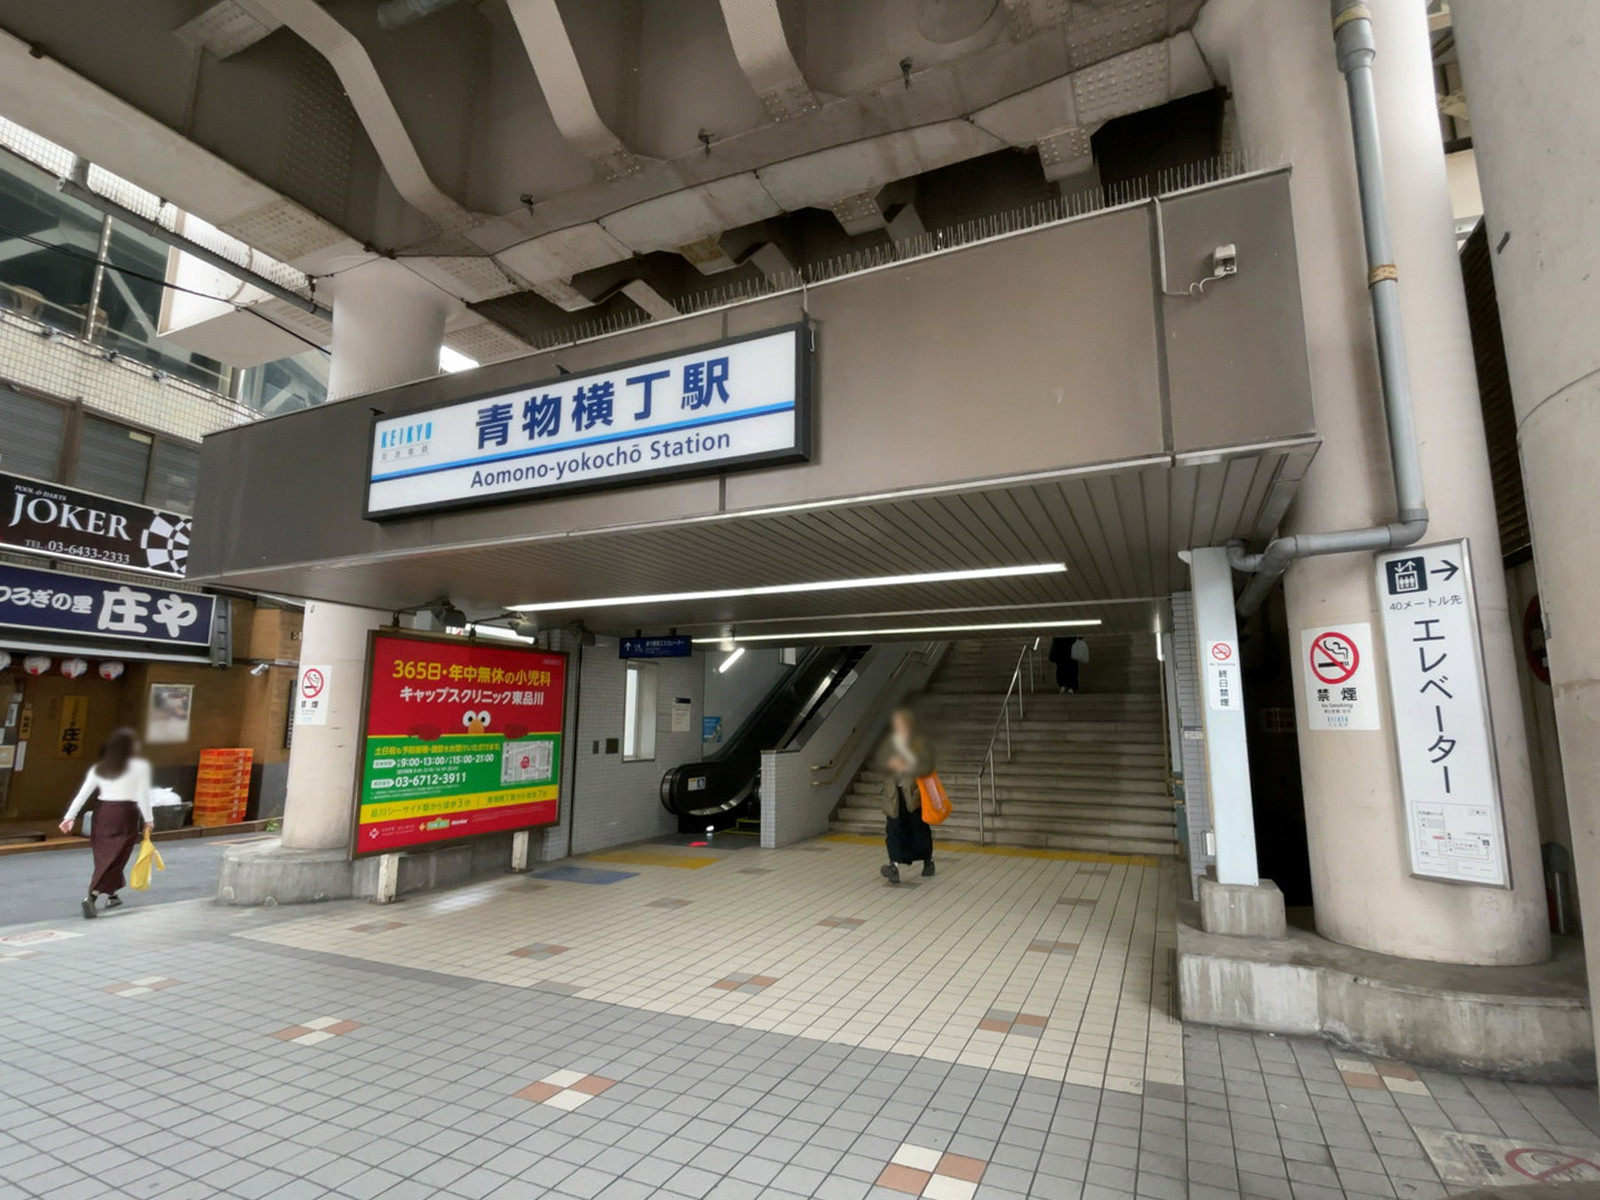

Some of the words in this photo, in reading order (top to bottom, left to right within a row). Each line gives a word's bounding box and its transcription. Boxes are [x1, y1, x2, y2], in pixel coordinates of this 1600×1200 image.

[475, 356, 730, 450] 青物横丁駅
[381, 422, 432, 449] KEIKYU
[470, 444, 642, 489] Aomono-yokochō
[650, 432, 731, 461] Station
[8, 492, 132, 541] JOKER
[48, 540, 131, 565] 03-6433-2333
[97, 586, 198, 638] 庄や
[1389, 594, 1463, 611] 40メートル先
[392, 659, 551, 687] 365日・年中無休の小児科
[399, 685, 545, 706] キャップスクリニック東品川
[1316, 687, 1357, 702] 禁煙
[1412, 619, 1457, 794] エレベーター
[395, 771, 467, 788] 03-6712-3911
